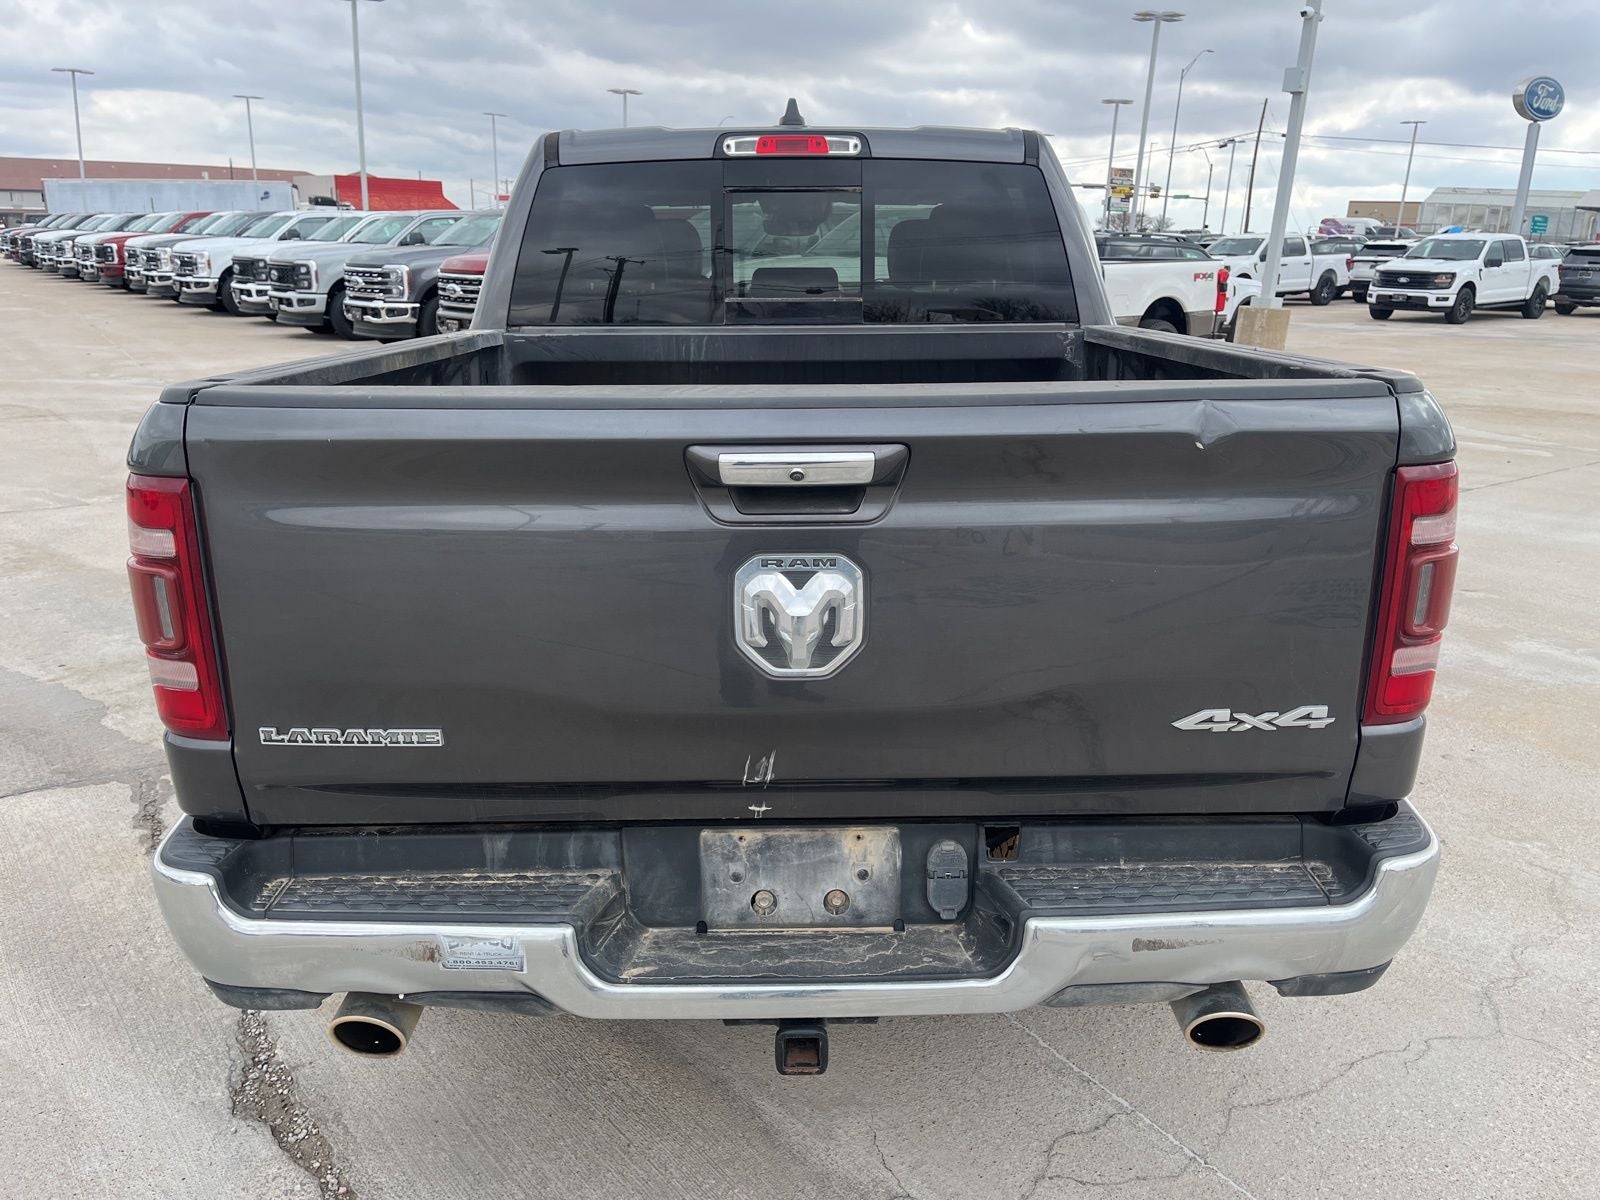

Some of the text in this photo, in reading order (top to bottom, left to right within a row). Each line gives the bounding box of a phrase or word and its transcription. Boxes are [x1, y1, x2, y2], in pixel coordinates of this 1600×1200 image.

[1533, 84, 1562, 111] Ford
[1193, 272, 1214, 282] FX4
[760, 558, 837, 568] RAM
[259, 727, 444, 747] LARAMIE
